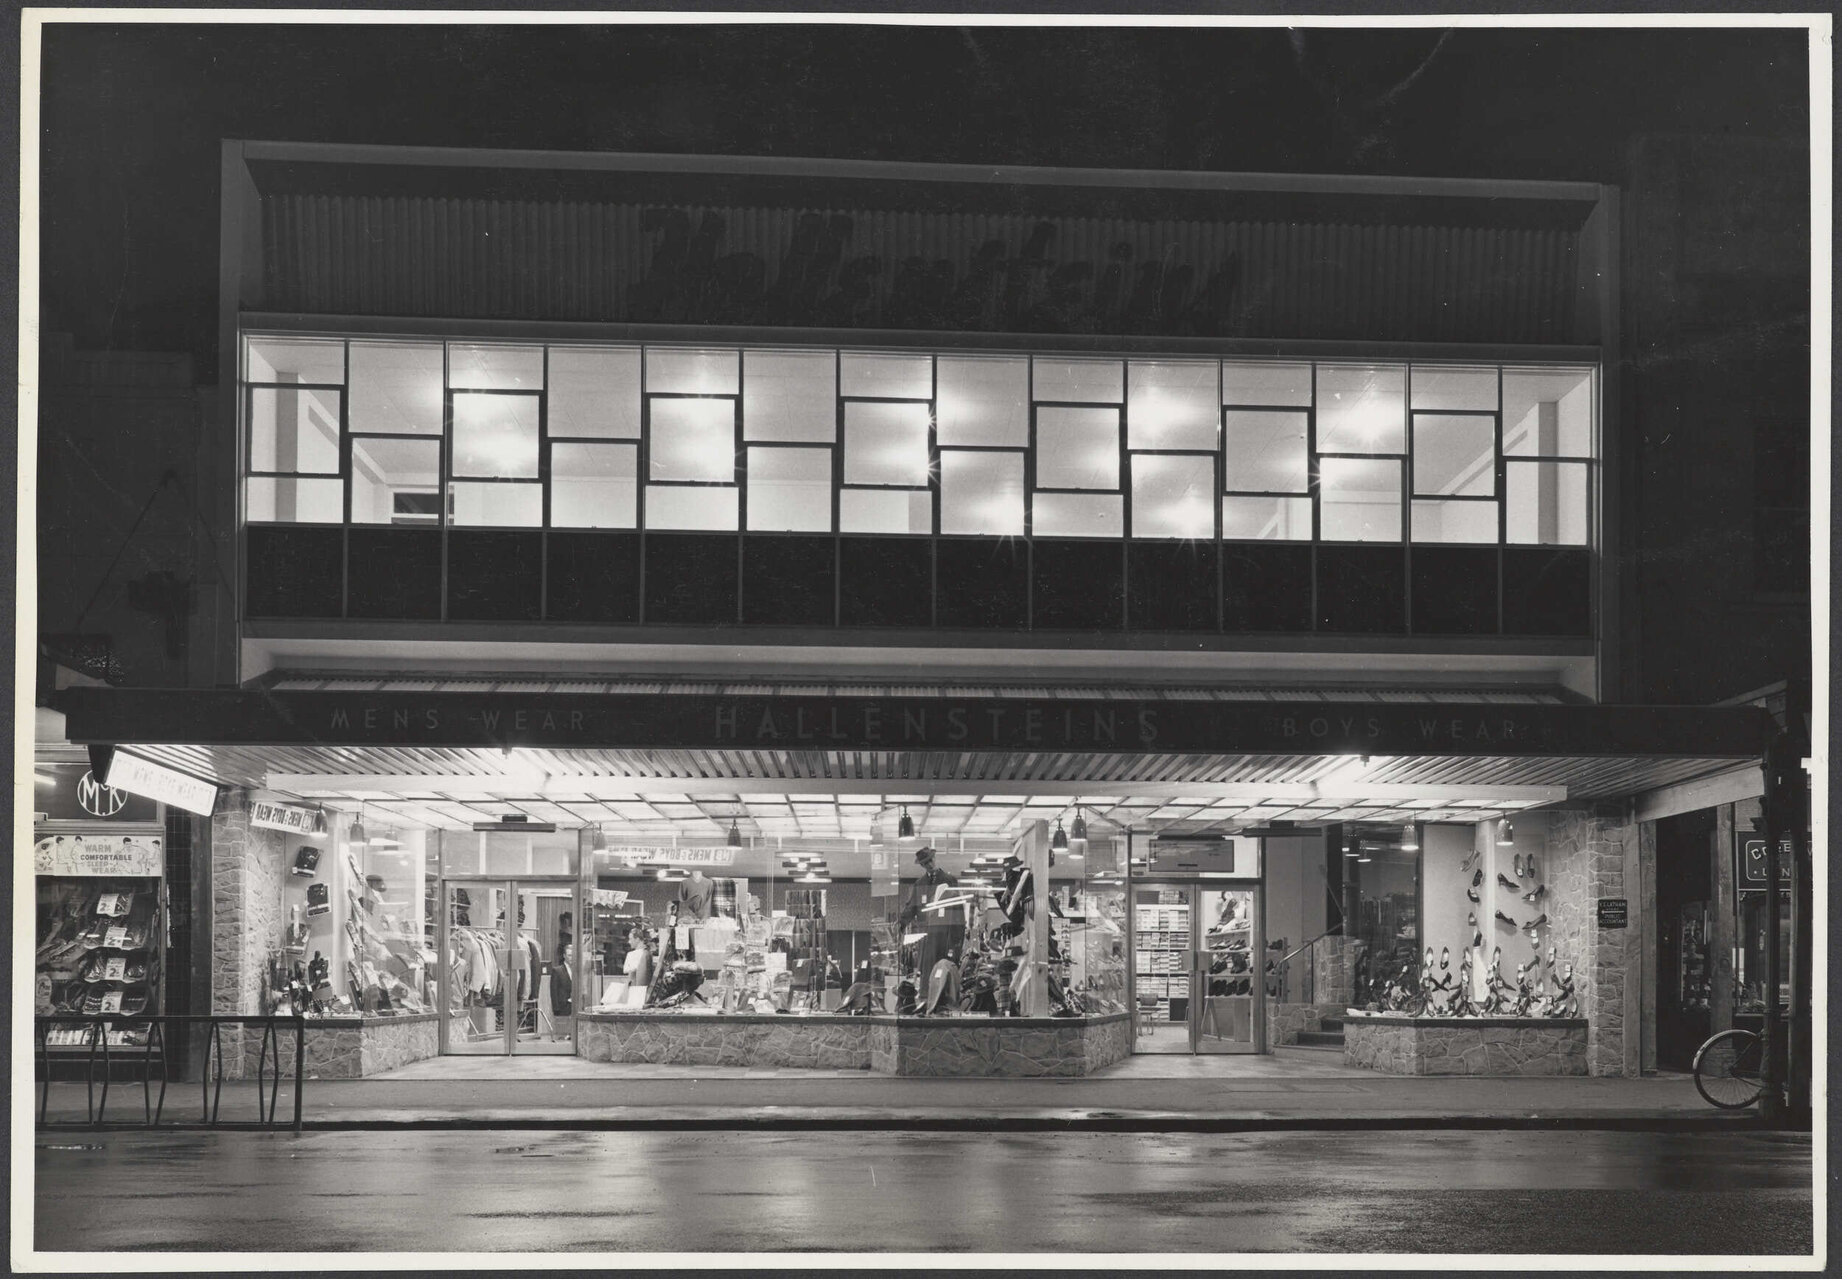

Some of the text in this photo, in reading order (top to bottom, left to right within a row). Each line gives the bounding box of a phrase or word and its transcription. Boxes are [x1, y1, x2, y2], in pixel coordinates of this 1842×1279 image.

[331, 708, 584, 731] MENS WEAR
[715, 706, 1158, 742] HALLENSTEINS
[1282, 717, 1516, 739] BOYS WEAR
[85, 845, 112, 853] WARM
